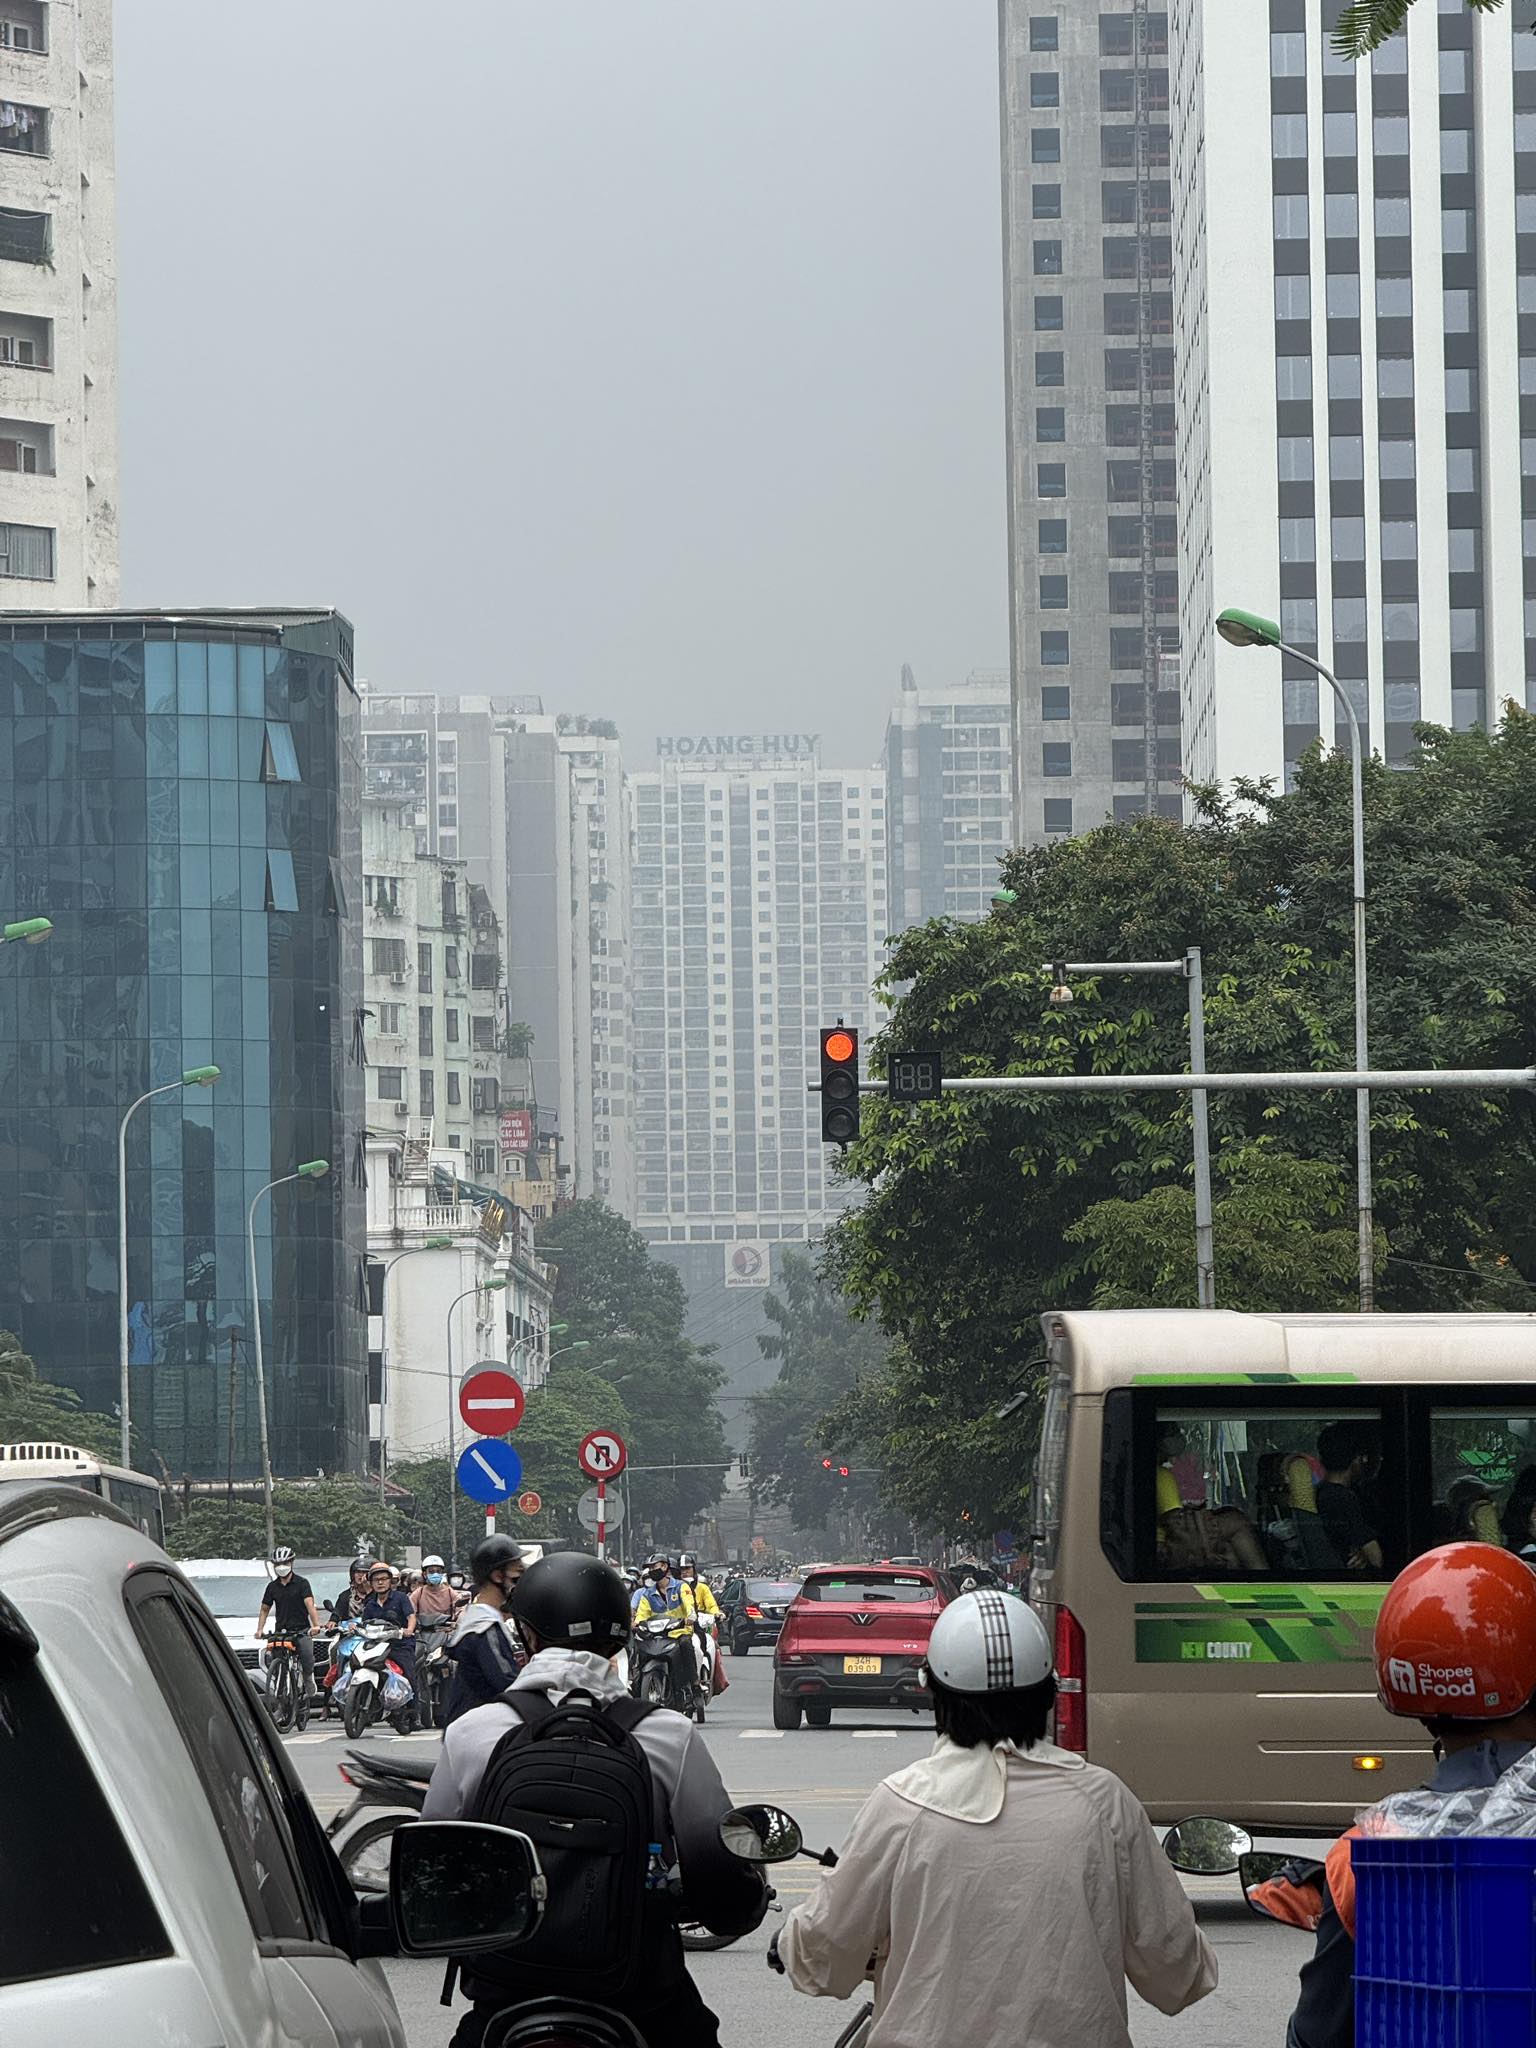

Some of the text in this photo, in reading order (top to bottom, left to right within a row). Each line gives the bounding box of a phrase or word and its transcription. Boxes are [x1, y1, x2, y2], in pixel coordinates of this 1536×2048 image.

[656, 735, 820, 756] HOANG HUY
[1418, 1663, 1473, 1682] Shopee
[1419, 1677, 1477, 1697] Food
